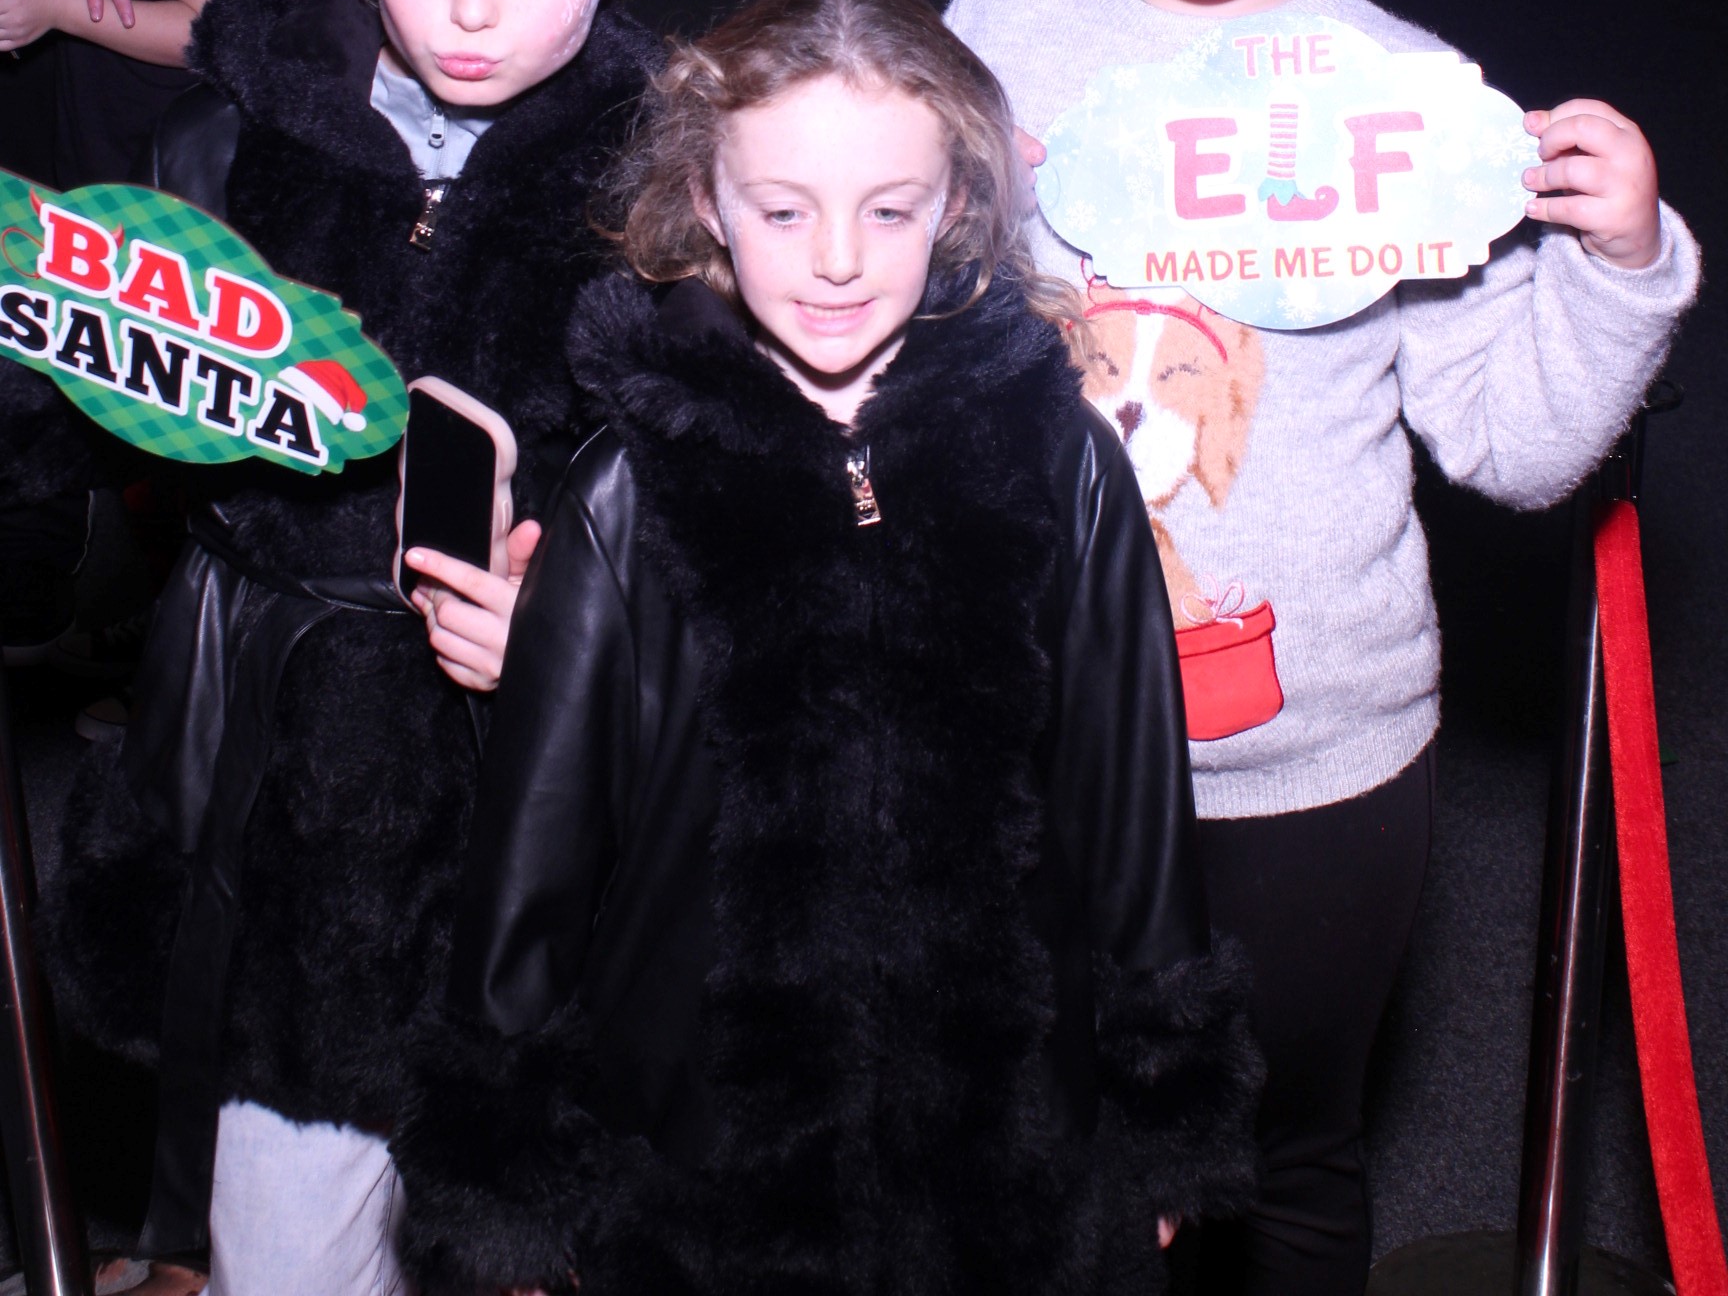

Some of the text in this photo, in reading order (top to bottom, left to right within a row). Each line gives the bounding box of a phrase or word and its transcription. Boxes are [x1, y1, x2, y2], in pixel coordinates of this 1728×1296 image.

[1235, 36, 1336, 76] THE
[1165, 104, 1425, 222] ELF
[45, 211, 286, 353] BAD
[1145, 241, 1454, 283] MADE ME DO IT
[0, 291, 321, 459] SANTA
